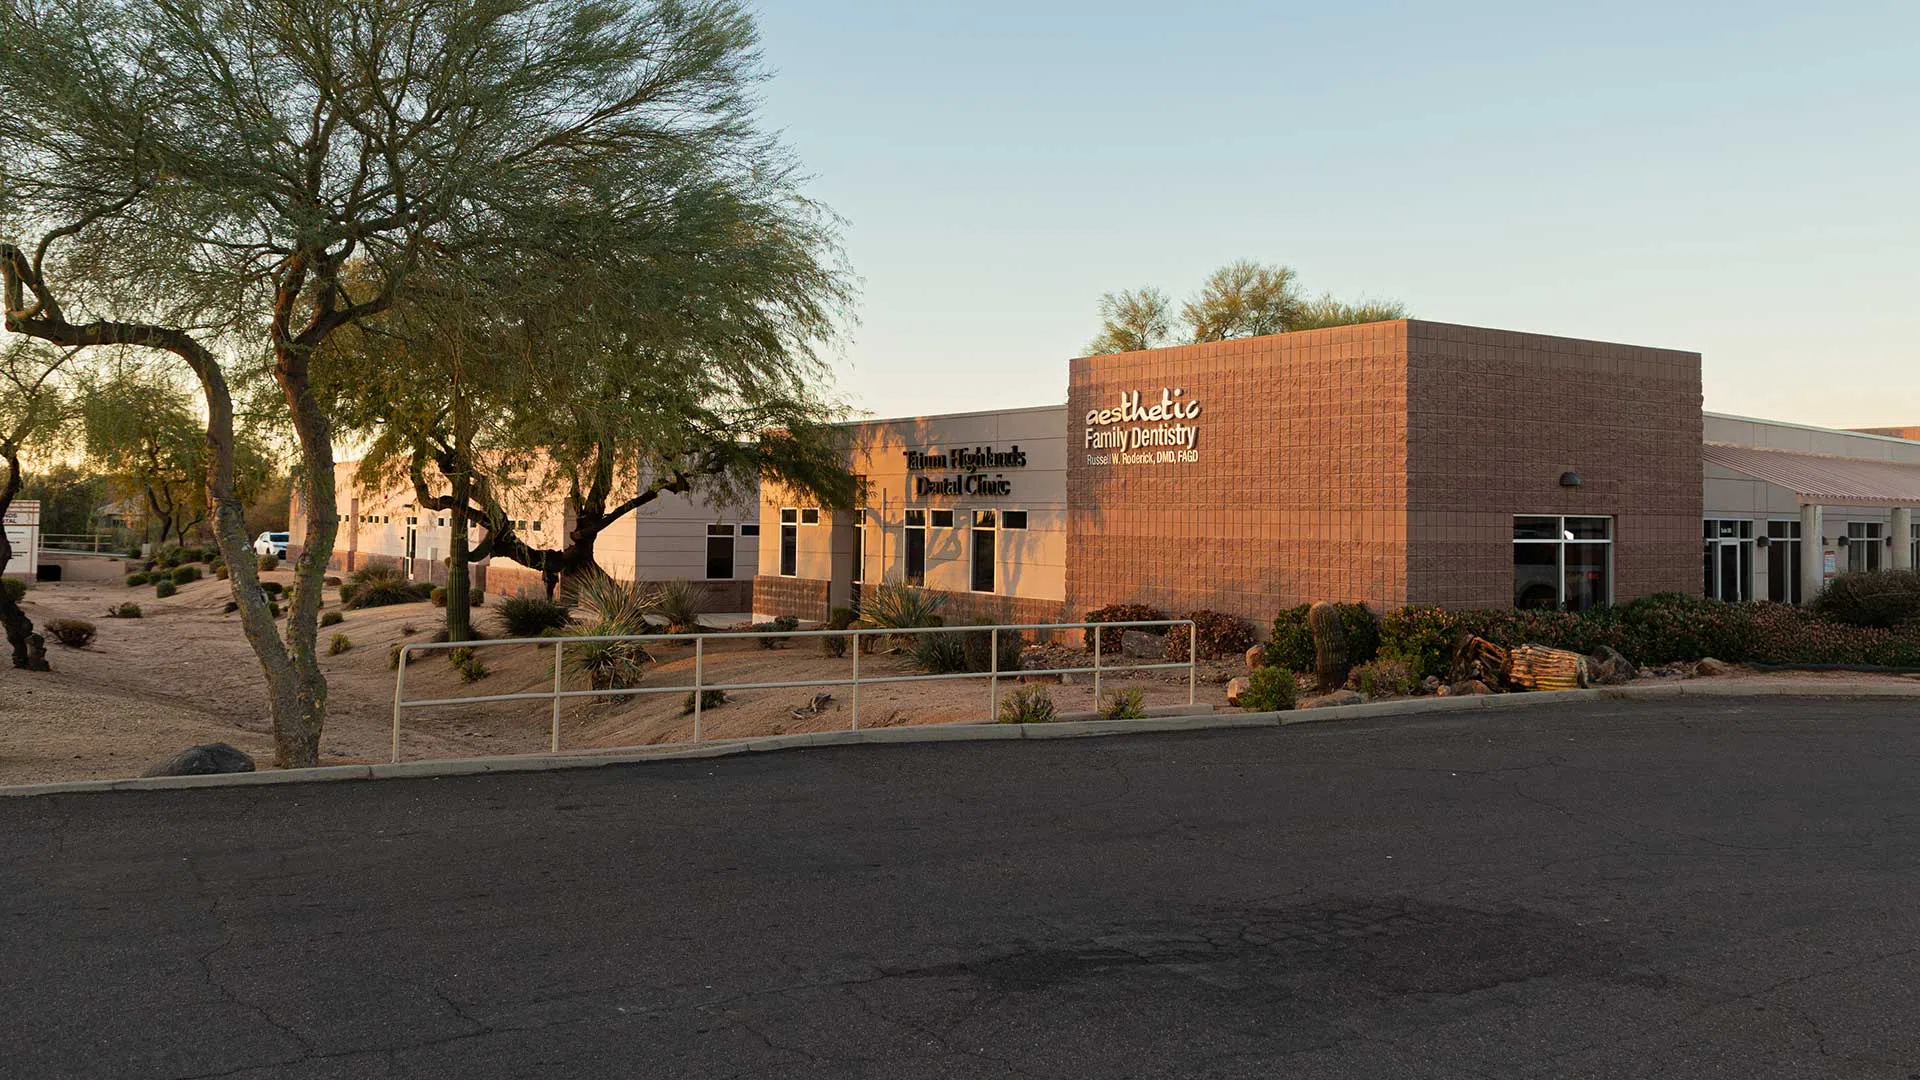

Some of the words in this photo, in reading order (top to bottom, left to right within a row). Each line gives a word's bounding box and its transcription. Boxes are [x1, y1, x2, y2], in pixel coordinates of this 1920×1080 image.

[1086, 387, 1199, 425] aesthetic
[1085, 427, 1129, 453] Family
[1131, 423, 1197, 450] Dentistry
[949, 445, 1027, 473] Highlands
[1111, 453, 1121, 465] W.
[1122, 451, 1156, 466] Roderick,
[1156, 450, 1177, 464] DMD,
[1177, 450, 1199, 463] FAGD
[917, 474, 963, 496] Dental
[964, 474, 1011, 496] Clinic
